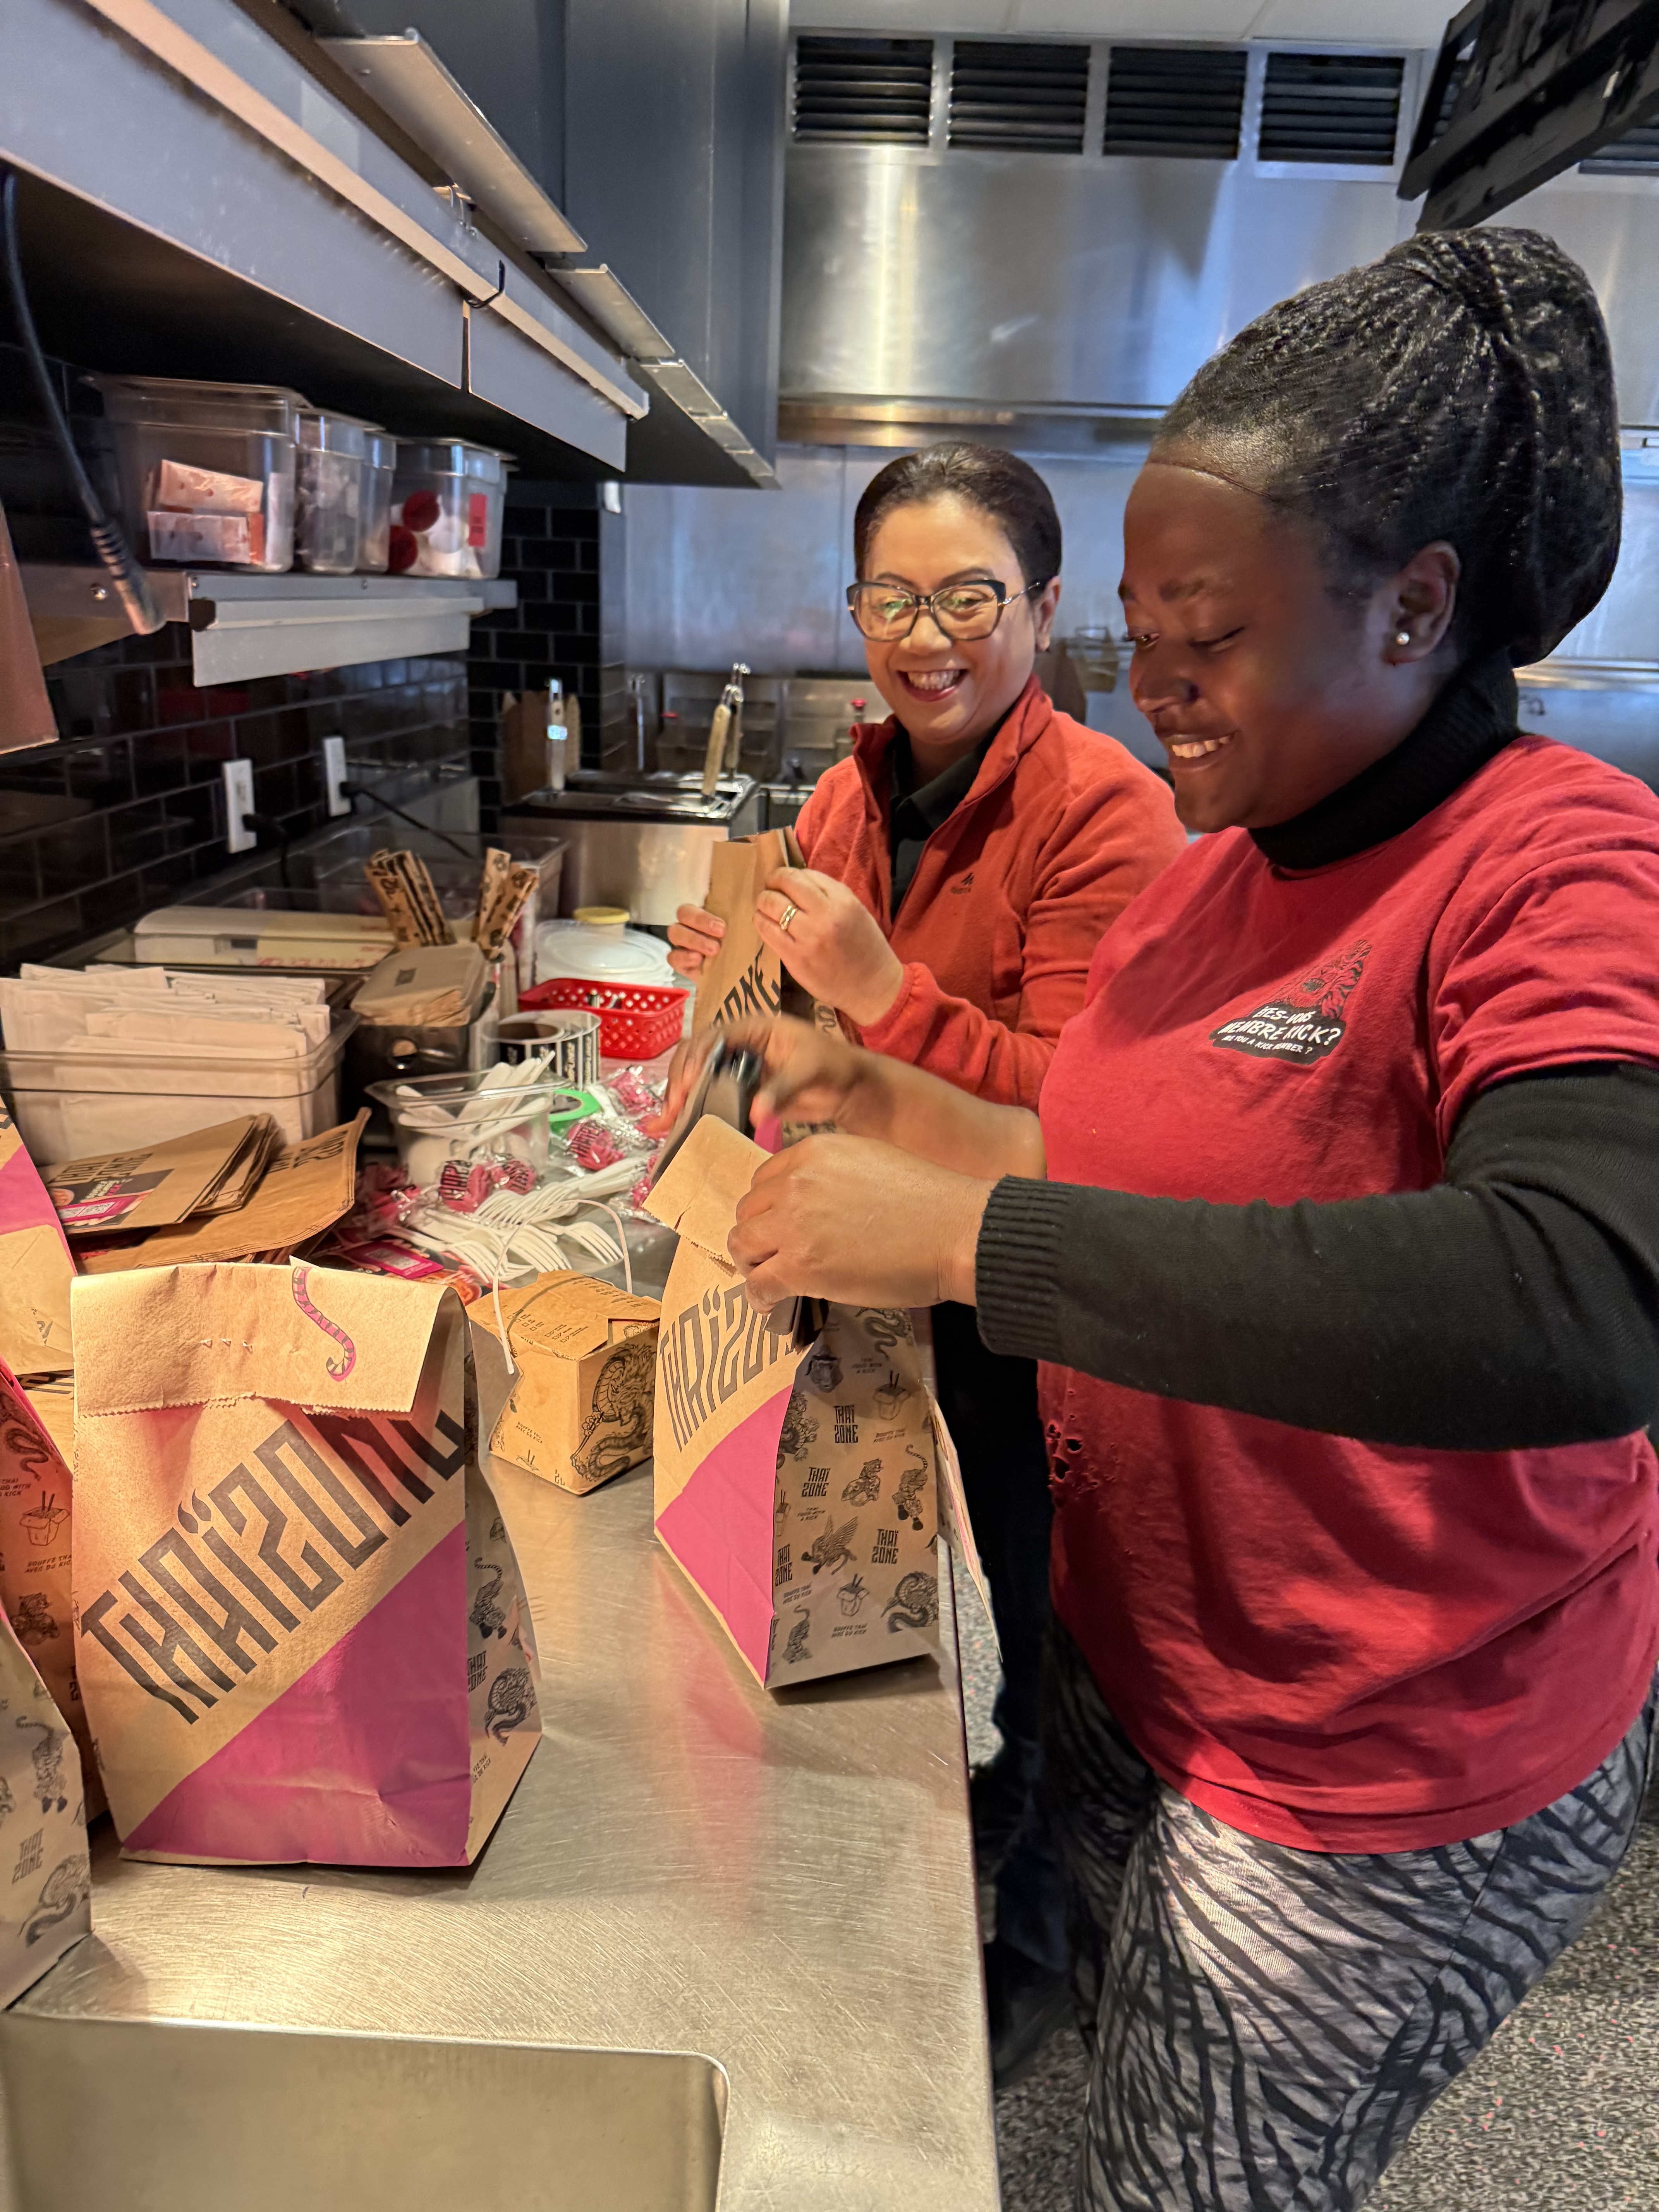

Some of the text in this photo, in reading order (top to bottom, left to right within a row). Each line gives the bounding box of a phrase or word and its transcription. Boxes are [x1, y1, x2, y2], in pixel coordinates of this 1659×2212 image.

[1218, 1020, 1341, 1046] MEMBRE KICK?
[1255, 1041, 1274, 1050] KICK
[834, 1424, 858, 1444] ZONE
[801, 1482, 829, 1497] ZONE
[58, 1559, 72, 1568] KIC
[871, 1546, 899, 1564] ZONE
[775, 1562, 792, 1587] ZONE
